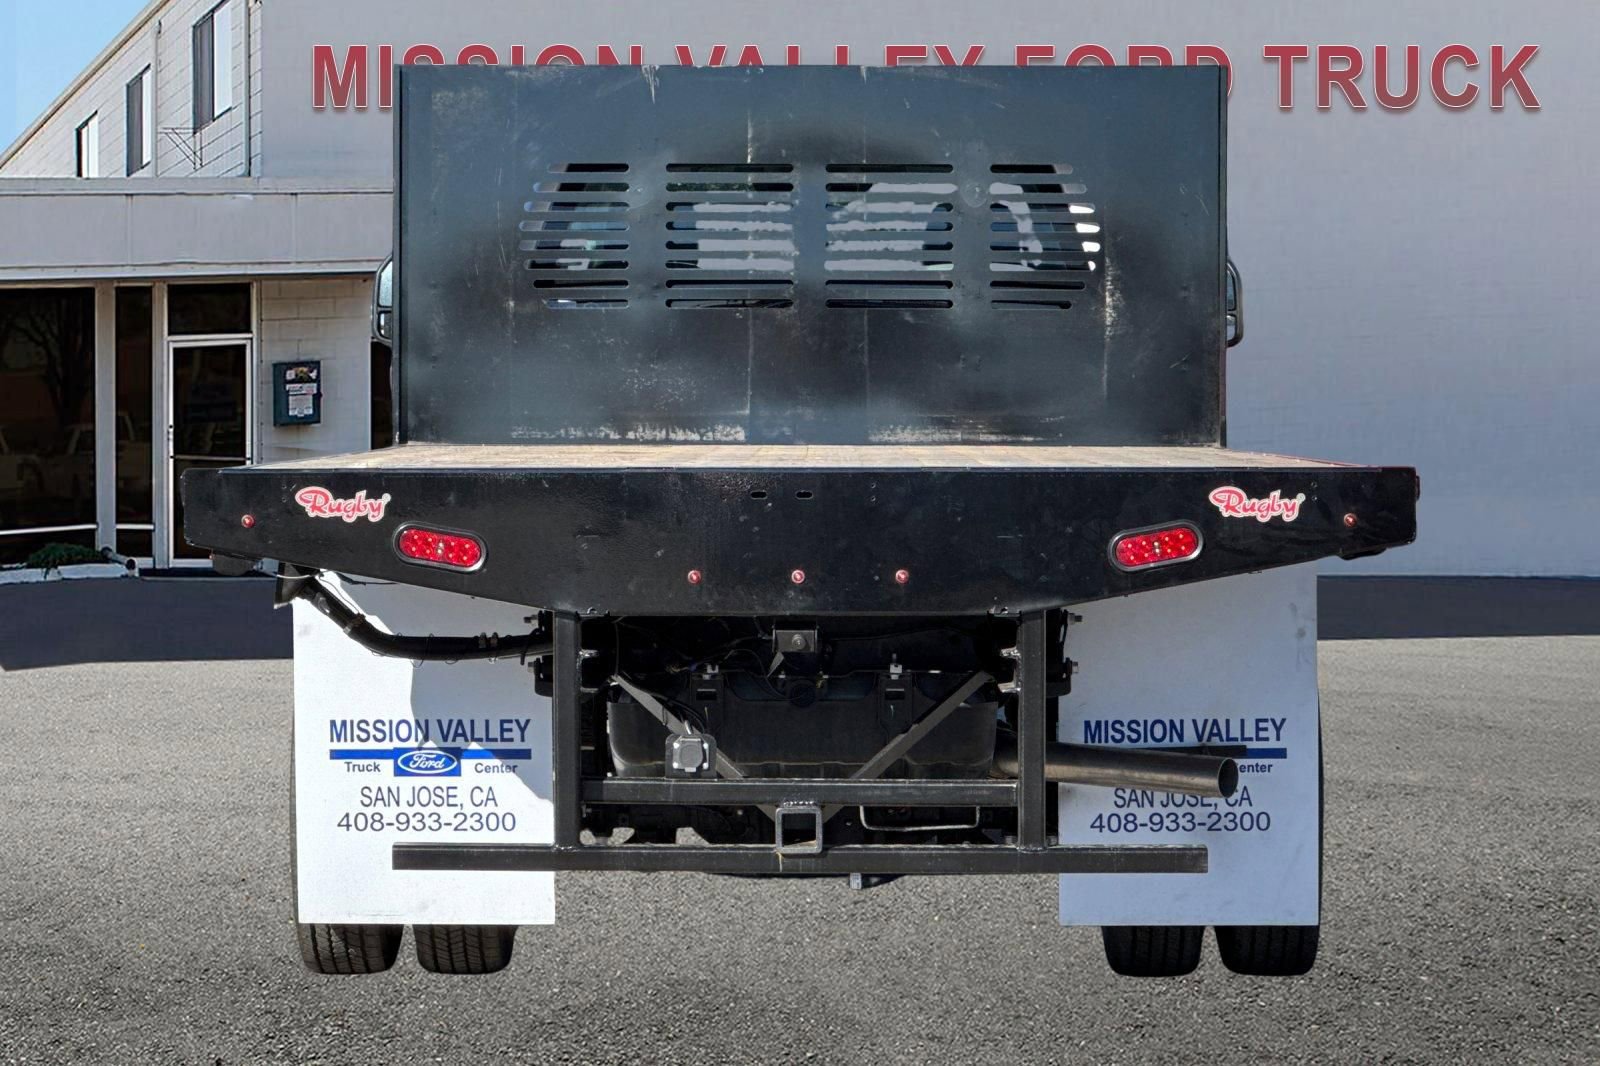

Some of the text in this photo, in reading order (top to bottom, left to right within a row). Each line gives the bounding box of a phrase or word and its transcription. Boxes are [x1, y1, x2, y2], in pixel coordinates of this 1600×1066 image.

[1262, 44, 1541, 109] TRUCK
[297, 488, 384, 520] Rugby
[1210, 487, 1299, 519] Rugby
[329, 719, 532, 743] MISSION VALLEY
[1083, 718, 1287, 744] MISSION VALLEY
[344, 753, 518, 774] Truck Ford Center
[1238, 762, 1273, 774] enter
[360, 786, 498, 810] SAN JOSE, CA
[1114, 787, 1155, 808] SAN
[337, 812, 516, 832] 408-933-2300
[1090, 811, 1272, 833] 408-933-2300
